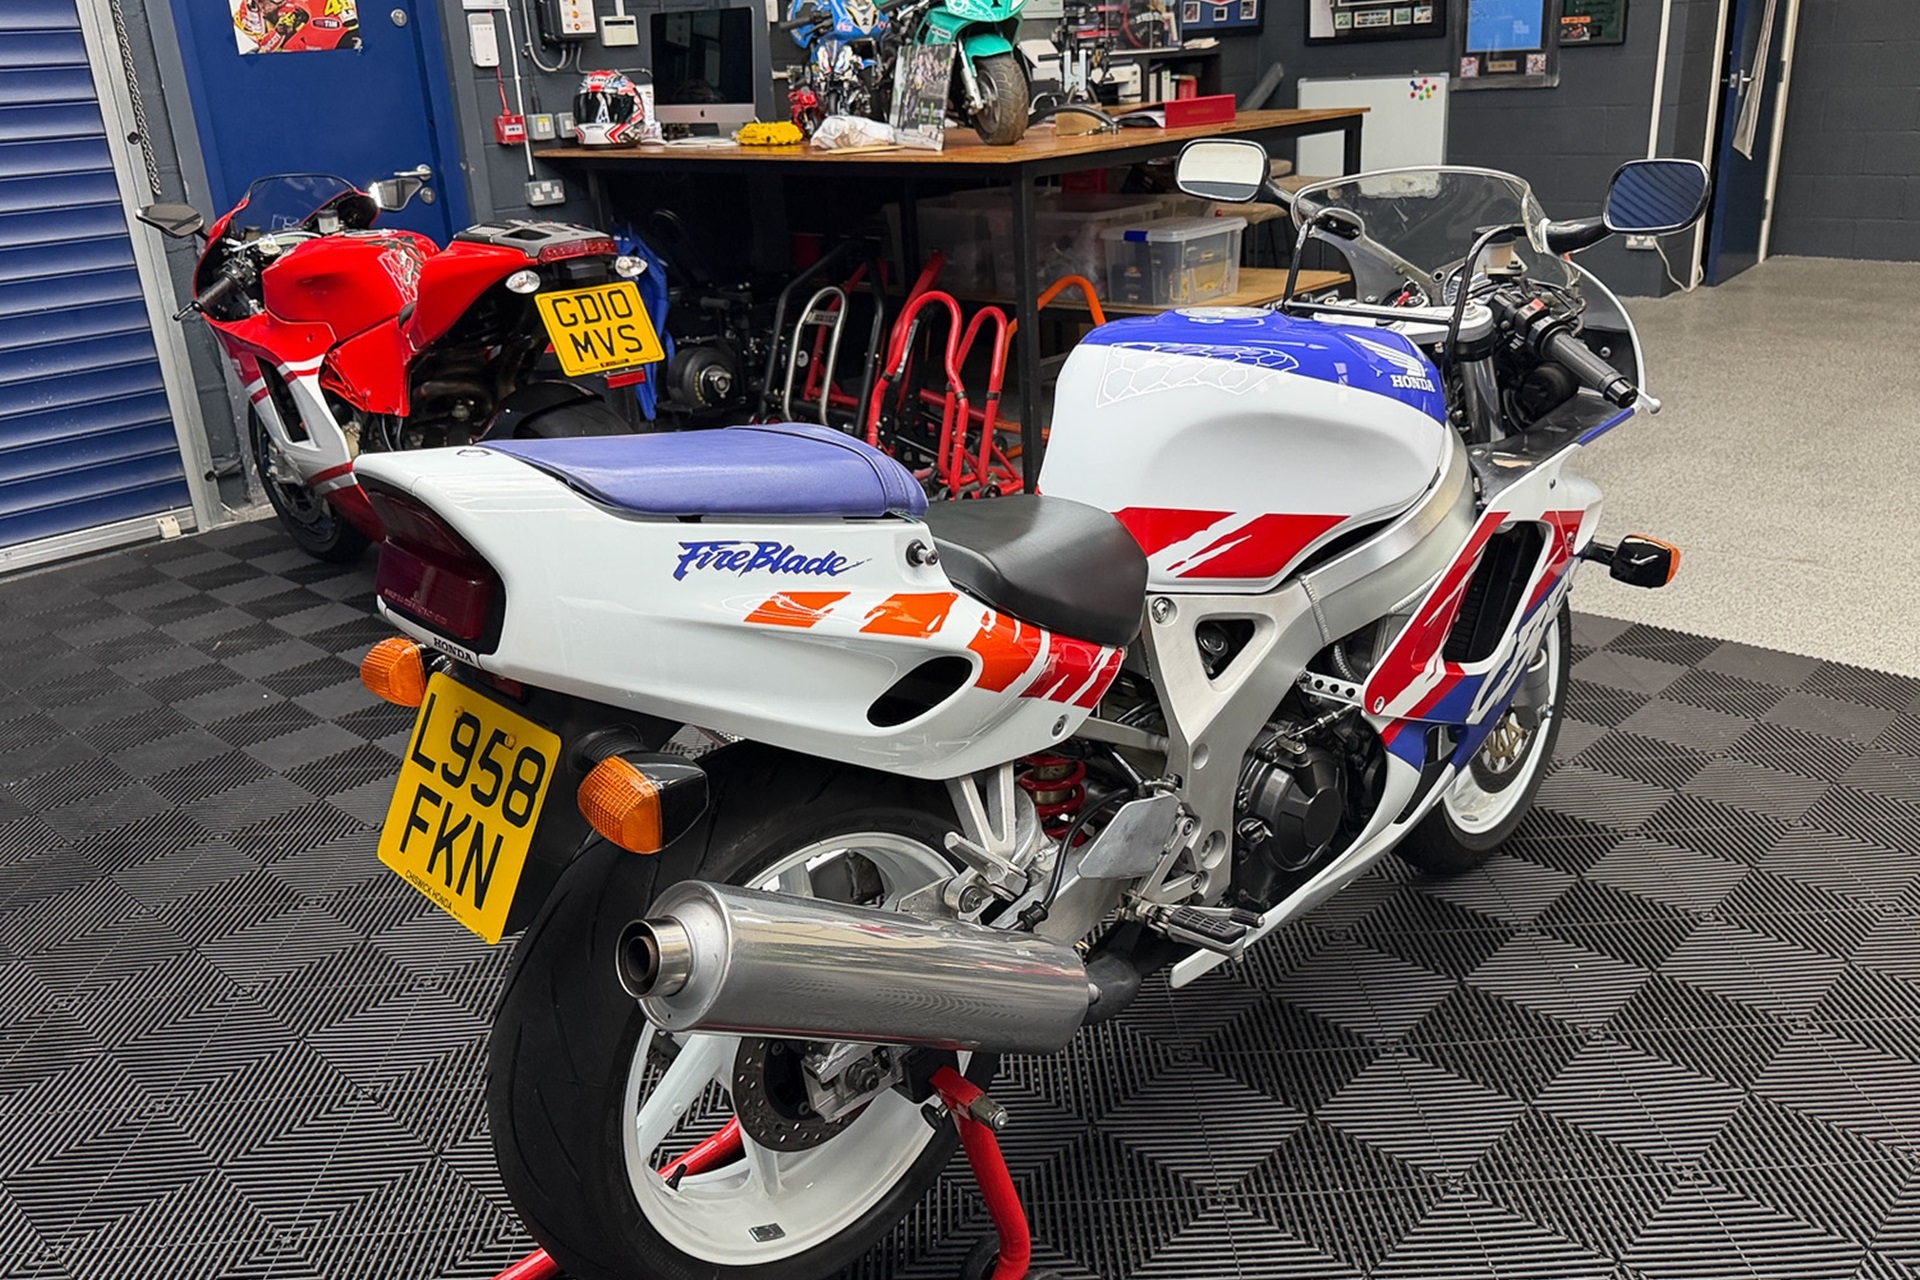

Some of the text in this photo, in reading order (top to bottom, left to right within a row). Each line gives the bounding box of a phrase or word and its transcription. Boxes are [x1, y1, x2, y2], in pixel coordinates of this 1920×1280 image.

[552, 289, 633, 327] GD10
[569, 324, 643, 362] MVS
[1390, 375, 1436, 393] HONDA
[433, 637, 474, 664] HONDA
[411, 693, 546, 829] L958
[399, 783, 505, 911] FKN
[404, 869, 453, 911] CHISWICK HONDA
